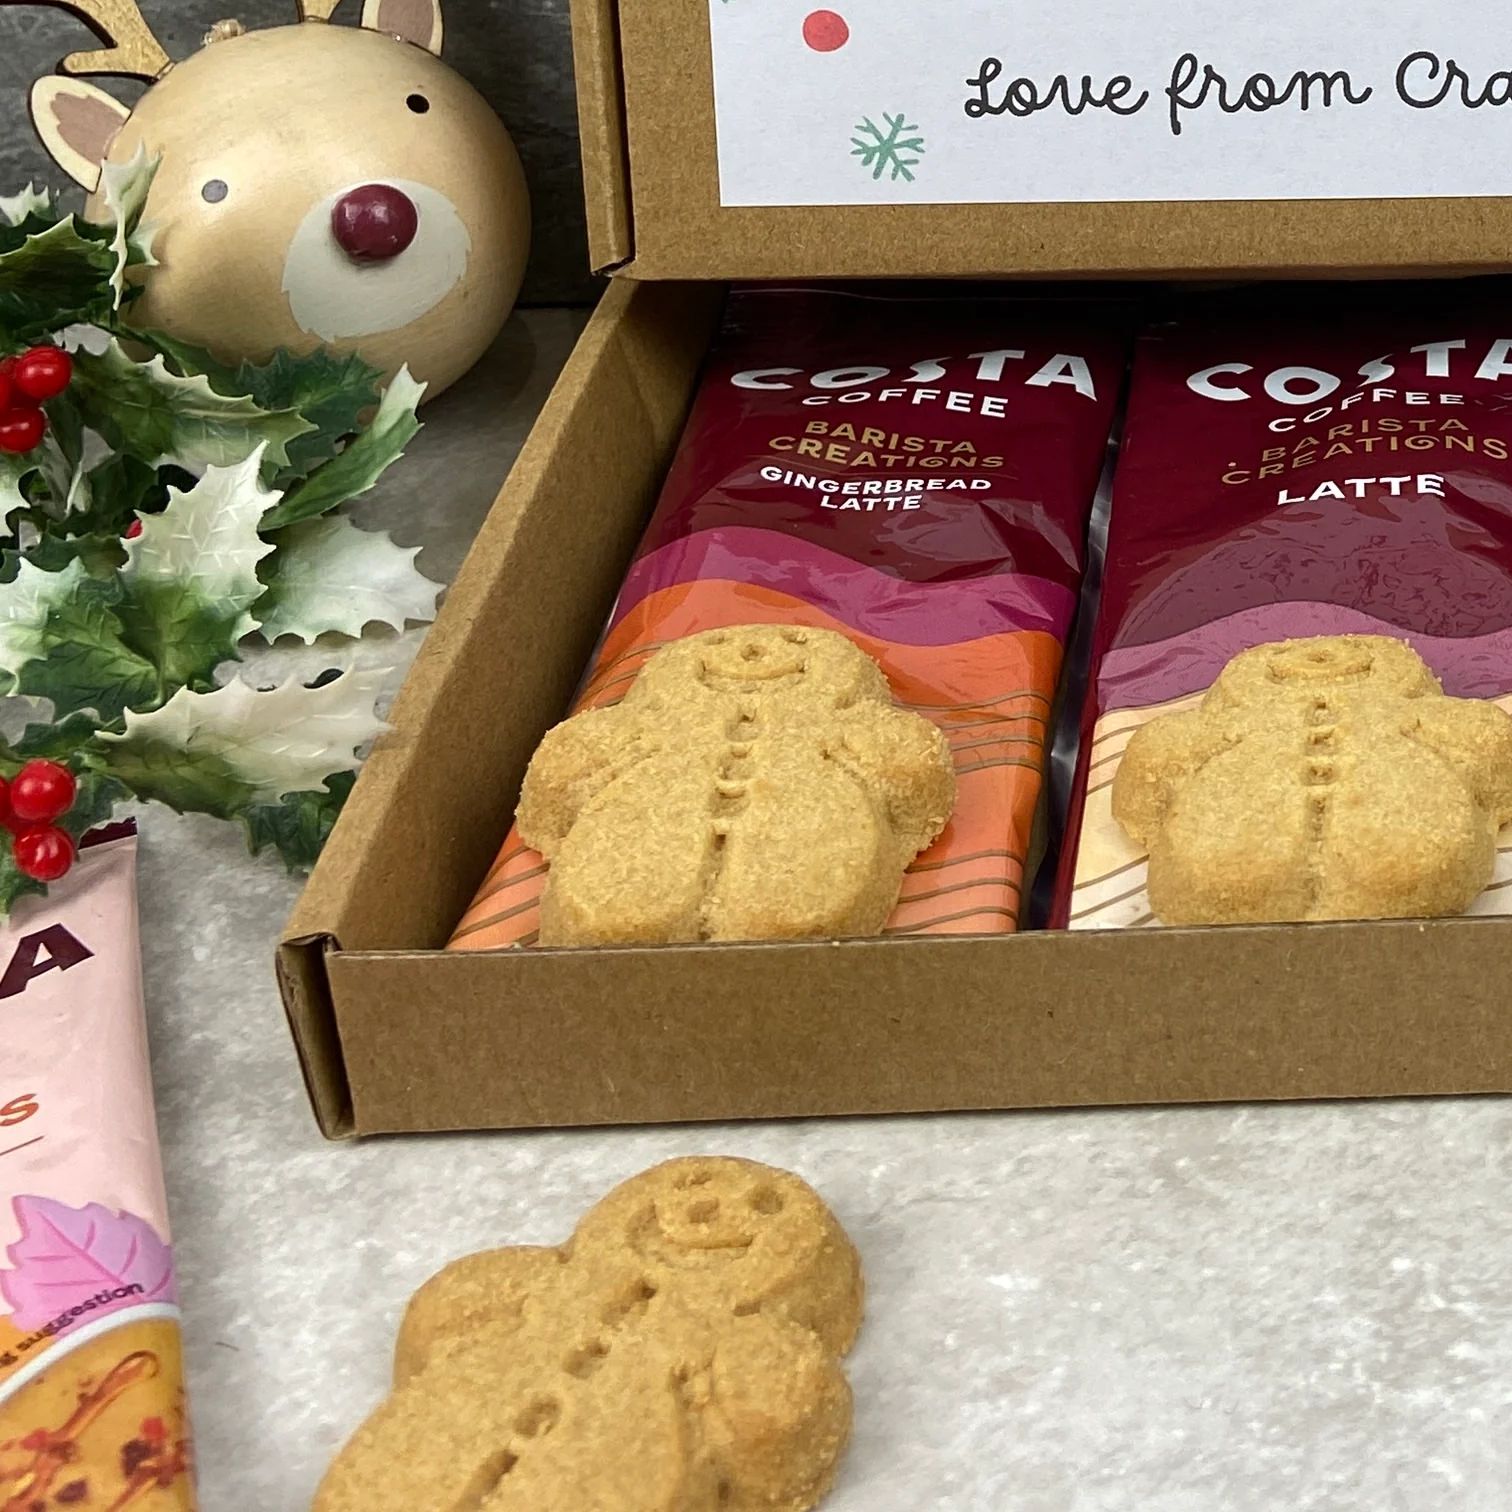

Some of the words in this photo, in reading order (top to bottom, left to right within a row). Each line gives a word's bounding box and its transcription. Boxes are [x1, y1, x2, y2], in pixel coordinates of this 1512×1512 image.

[963, 56, 1149, 117] Love
[1165, 52, 1373, 136] from
[730, 349, 1098, 402] COSTA
[801, 388, 1010, 419] COFFEE
[1267, 387, 1466, 433] COFFEE
[768, 435, 1006, 469] CREATIONS
[804, 420, 978, 455] BARISTA
[1260, 418, 1470, 464] BARISTA
[1220, 434, 1509, 486] CREATIONS
[759, 465, 993, 497] GINGERBREAD
[1275, 472, 1447, 507] LATTE
[818, 493, 924, 513] LATTE
